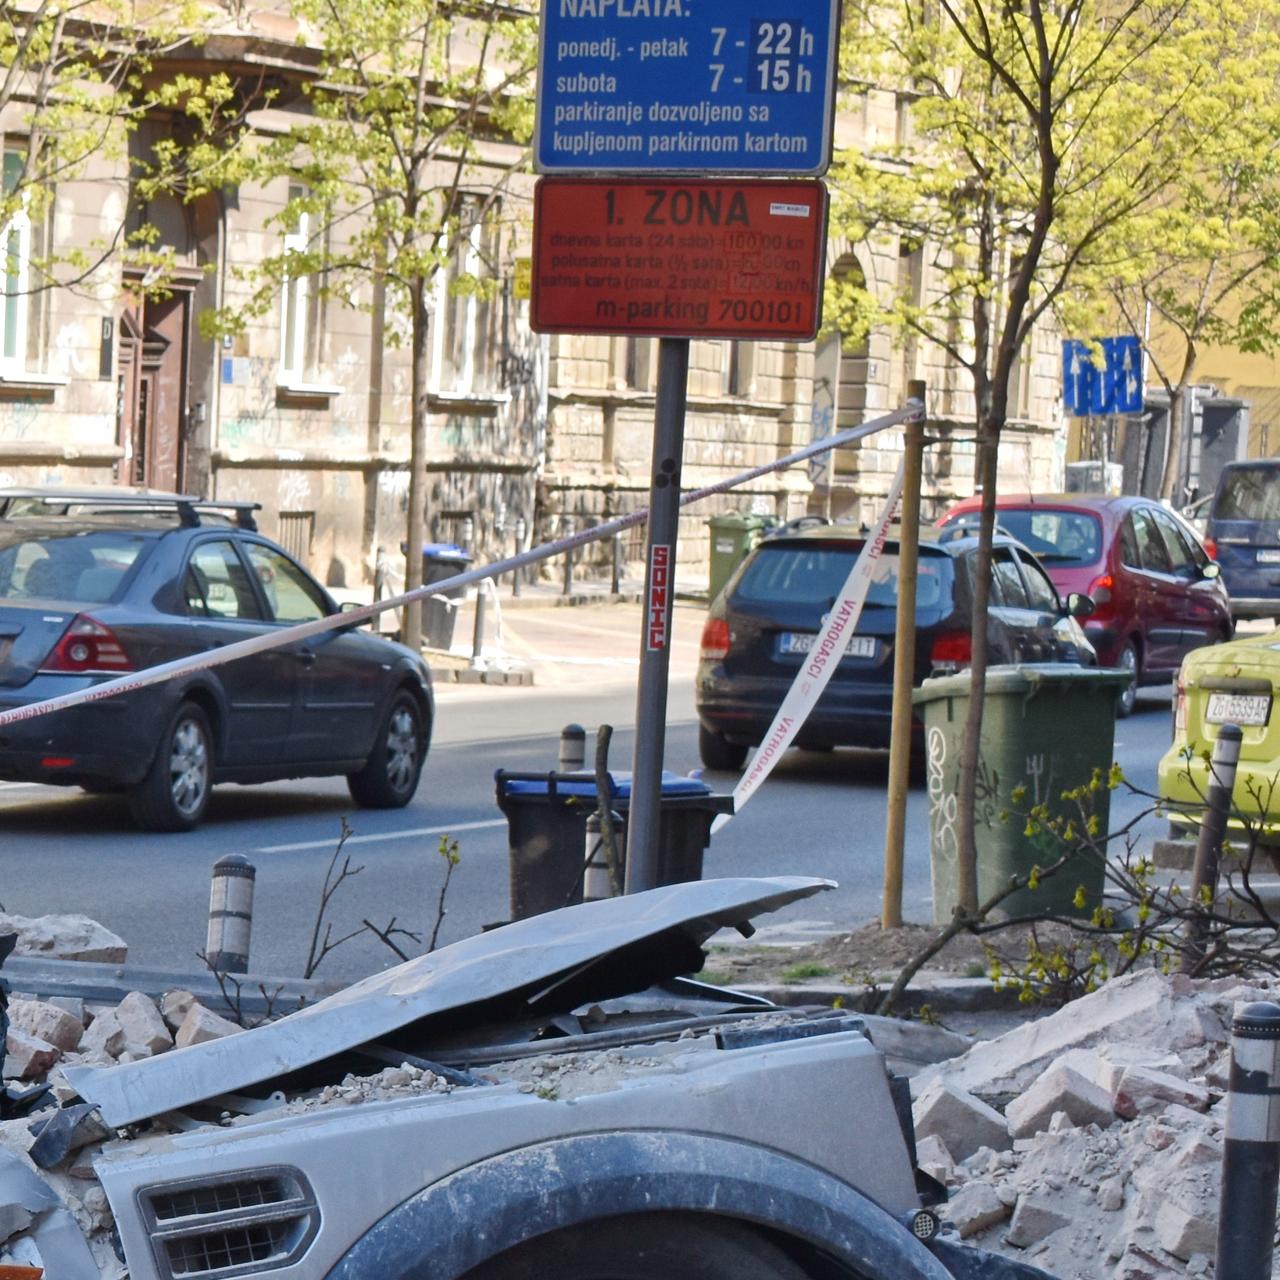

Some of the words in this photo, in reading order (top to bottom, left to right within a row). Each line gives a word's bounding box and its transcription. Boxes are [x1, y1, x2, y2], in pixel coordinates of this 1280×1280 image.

[558, 38, 621, 61] ponedj.
[640, 38, 688, 61] petak
[711, 28, 727, 56] 7
[757, 23, 792, 54] 22
[800, 27, 814, 55] h
[556, 73, 616, 93] subota
[709, 64, 724, 92] 7
[757, 60, 790, 91] 15
[797, 65, 811, 92] h
[555, 102, 642, 126] parkiranje
[649, 102, 742, 126] dozvoljeno
[749, 105, 769, 121] sa
[553, 132, 642, 155] kupljenom
[649, 132, 738, 155] parkirnom
[745, 132, 808, 153] kartom
[644, 189, 750, 227] ZONA
[550, 234, 601, 248] dnevna
[607, 234, 643, 248] karta
[551, 254, 621, 271] polusatna
[625, 255, 664, 269] karta
[585, 273, 621, 289] karta
[596, 294, 710, 325] m-parking
[717, 299, 802, 324] 700101
[648, 545, 670, 650] SONIC
[806, 599, 857, 679] VATROGASCI
[742, 716, 794, 793] VATROGASCI
